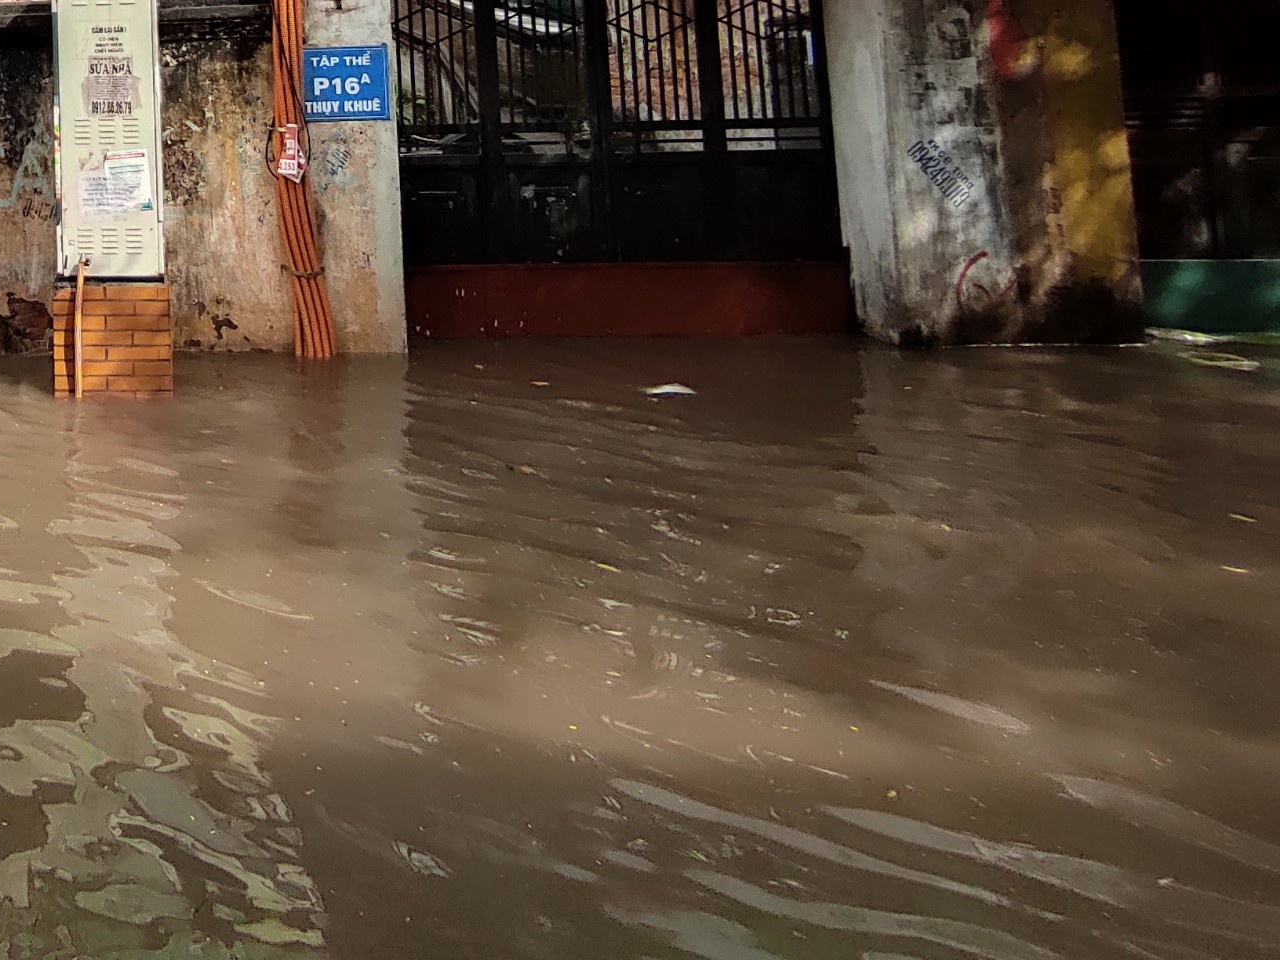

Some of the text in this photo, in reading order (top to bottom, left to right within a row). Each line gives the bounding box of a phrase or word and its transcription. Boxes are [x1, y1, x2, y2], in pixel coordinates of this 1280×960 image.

[89, 60, 109, 75] SỬA
[310, 50, 371, 70] TẬP THỂ
[305, 97, 381, 116] THỤY KHUÊ
